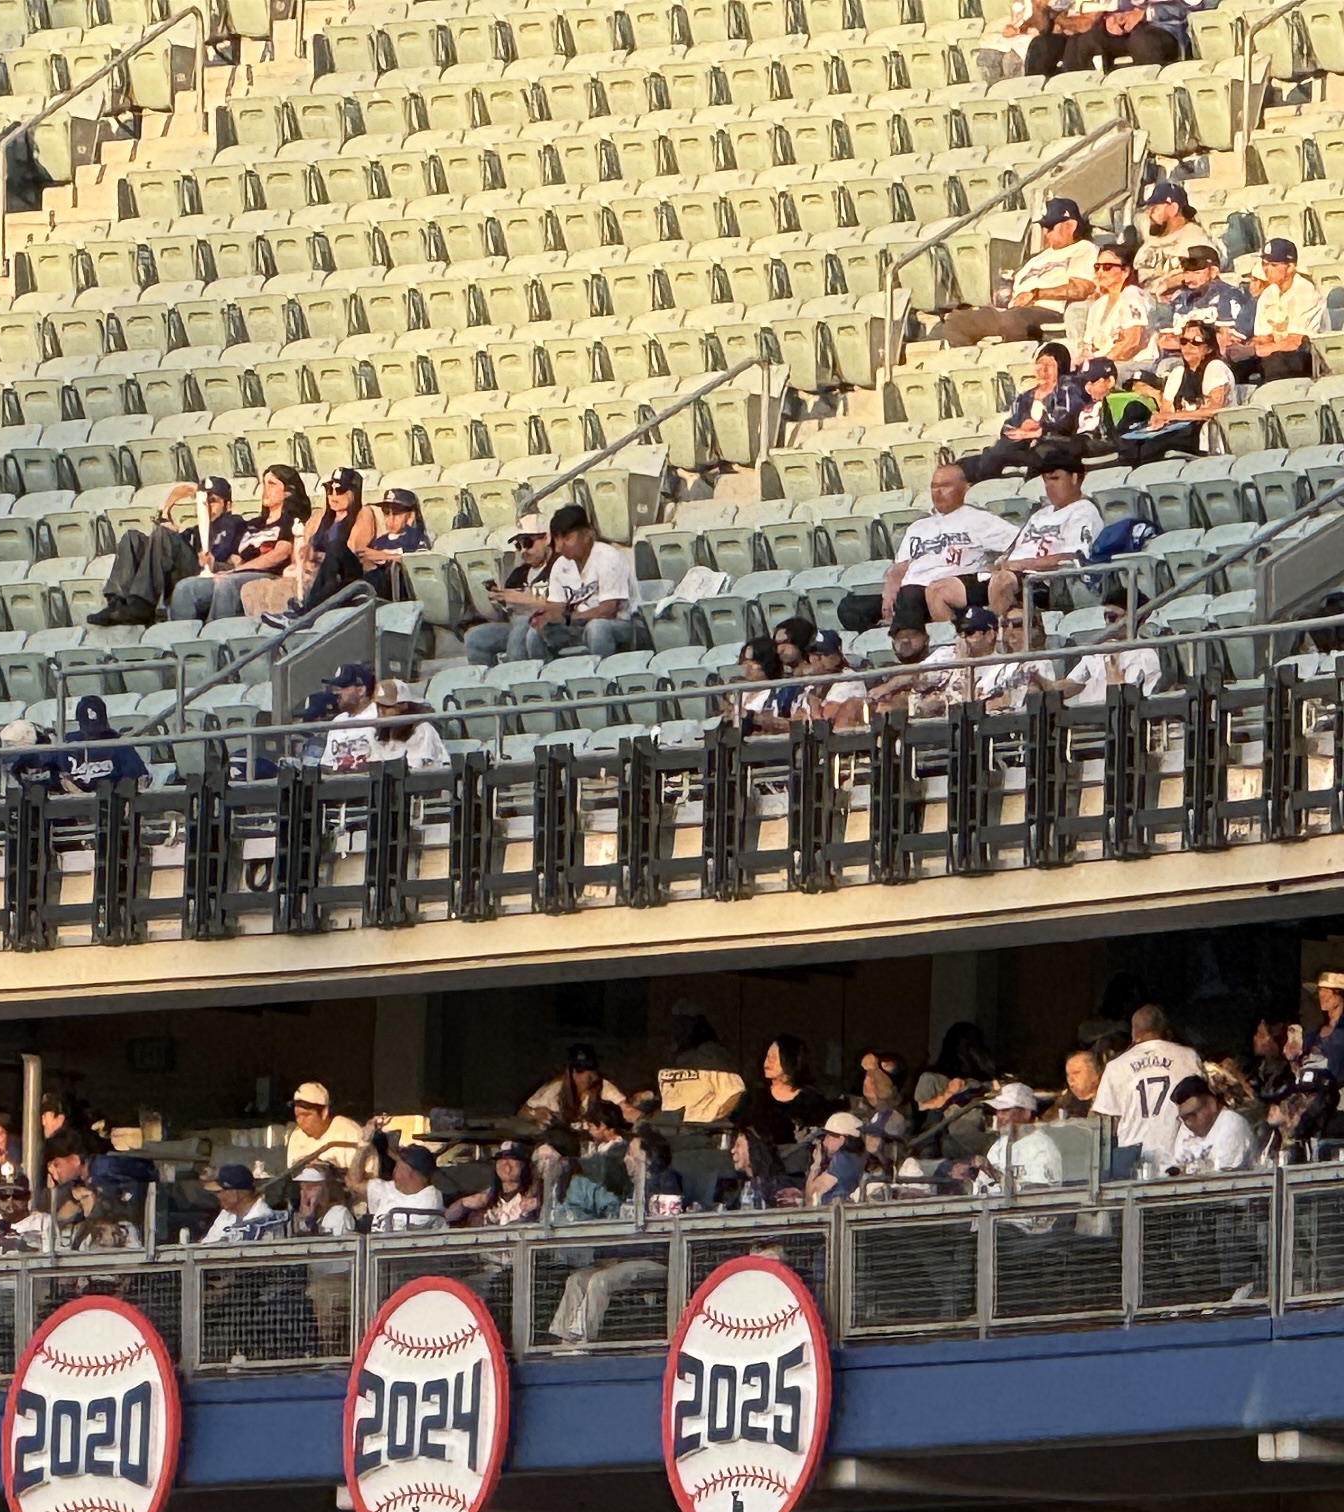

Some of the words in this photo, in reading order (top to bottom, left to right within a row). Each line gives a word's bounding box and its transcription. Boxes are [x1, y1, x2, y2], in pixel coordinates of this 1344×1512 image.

[1135, 1075, 1171, 1119] 17
[15, 1381, 151, 1493] 2020
[355, 1361, 481, 1474] 2024
[675, 1345, 803, 1457] 2025
